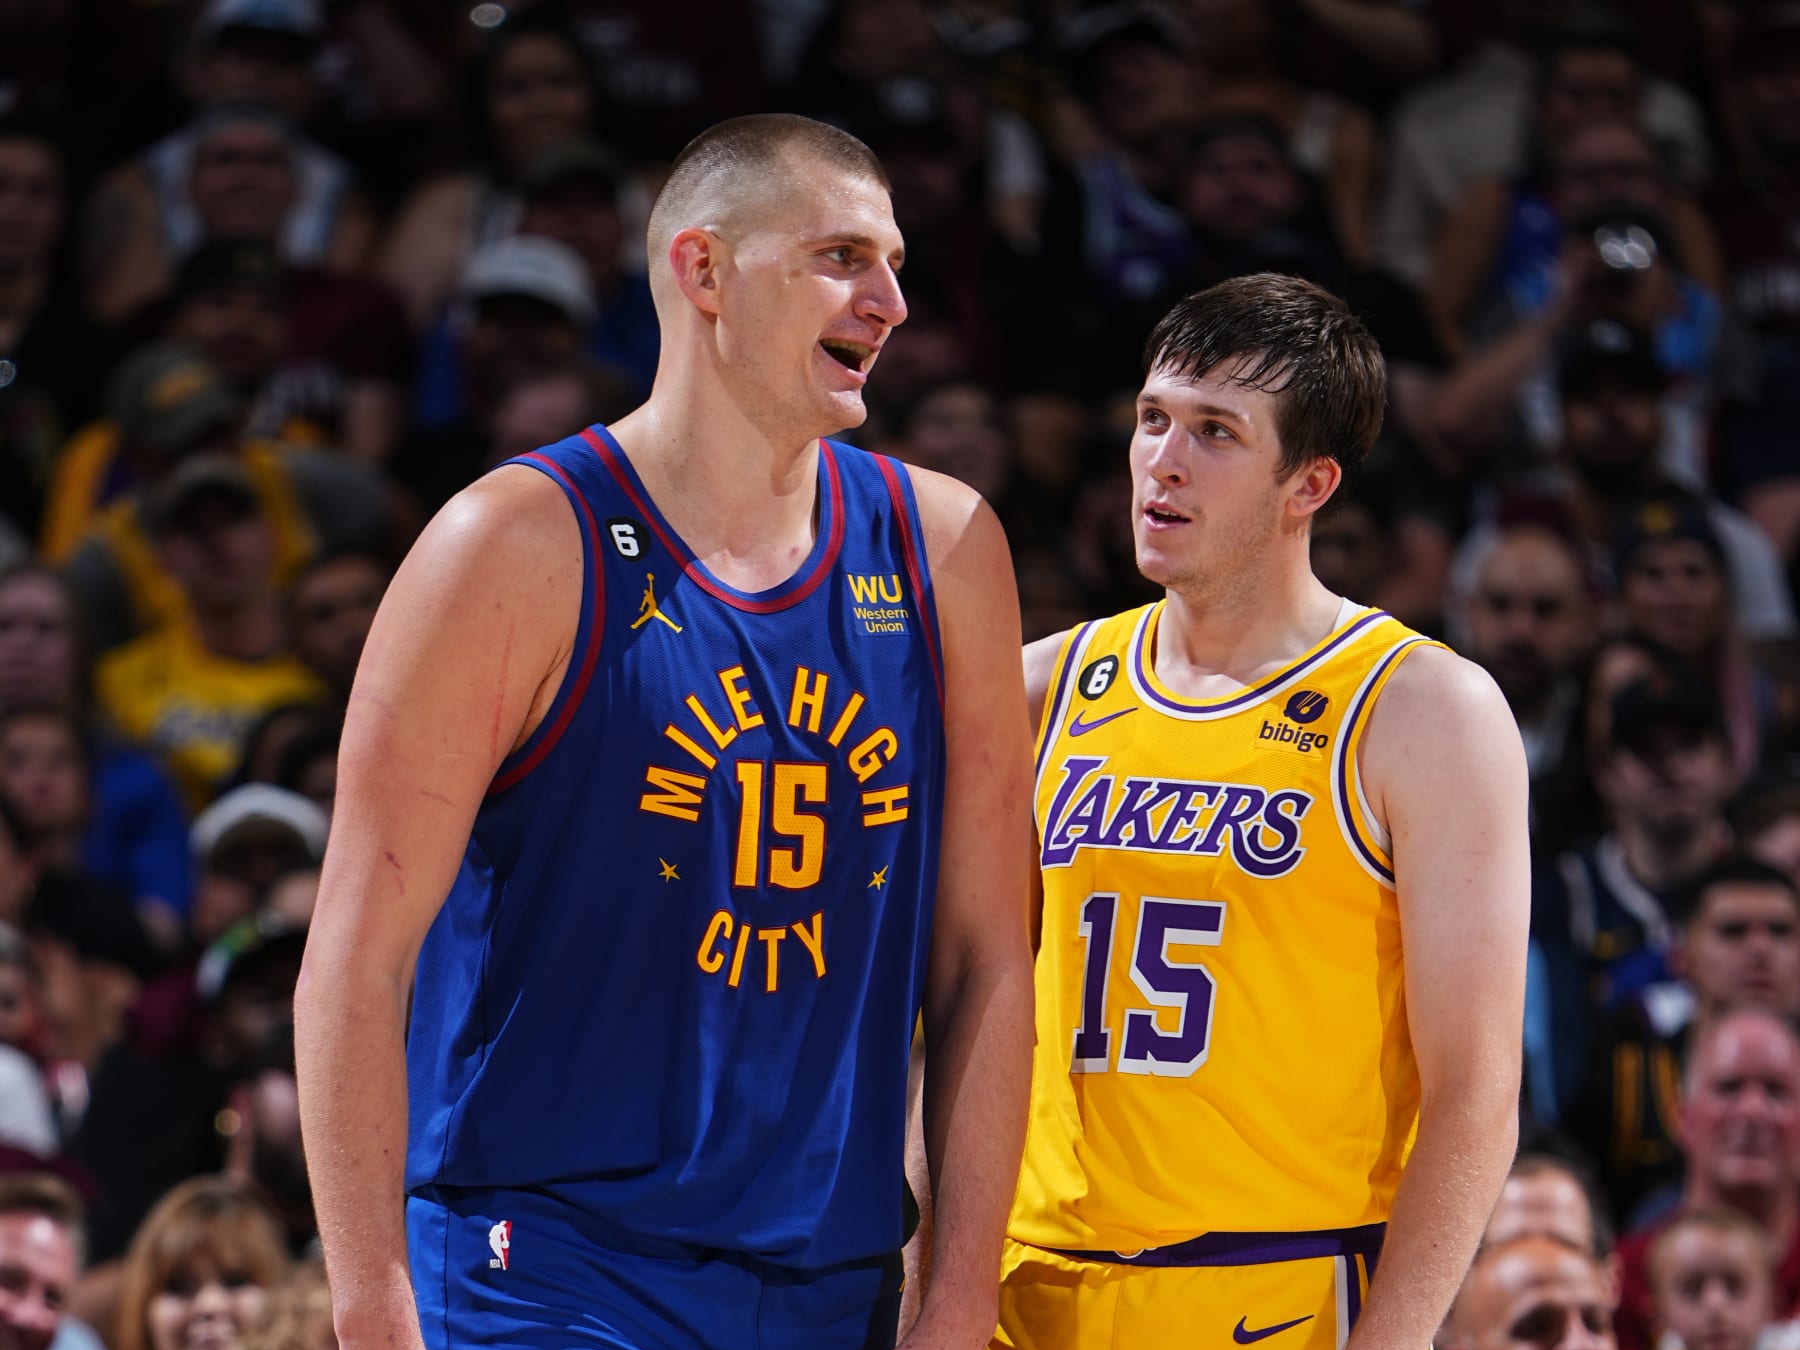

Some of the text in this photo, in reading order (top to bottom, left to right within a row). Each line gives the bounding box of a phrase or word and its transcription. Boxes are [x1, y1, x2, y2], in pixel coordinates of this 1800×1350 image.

[610, 523, 640, 558] 6
[847, 573, 904, 604] WU
[852, 606, 910, 620] Western
[864, 619, 905, 634] Union
[1086, 660, 1114, 695] 6
[639, 663, 910, 829] MILE HIGH
[1258, 720, 1329, 753] bibigo
[732, 758, 830, 890] 15
[1040, 754, 1316, 880] LAKERS
[695, 907, 828, 994] CITY
[1068, 891, 1227, 1079] 15
